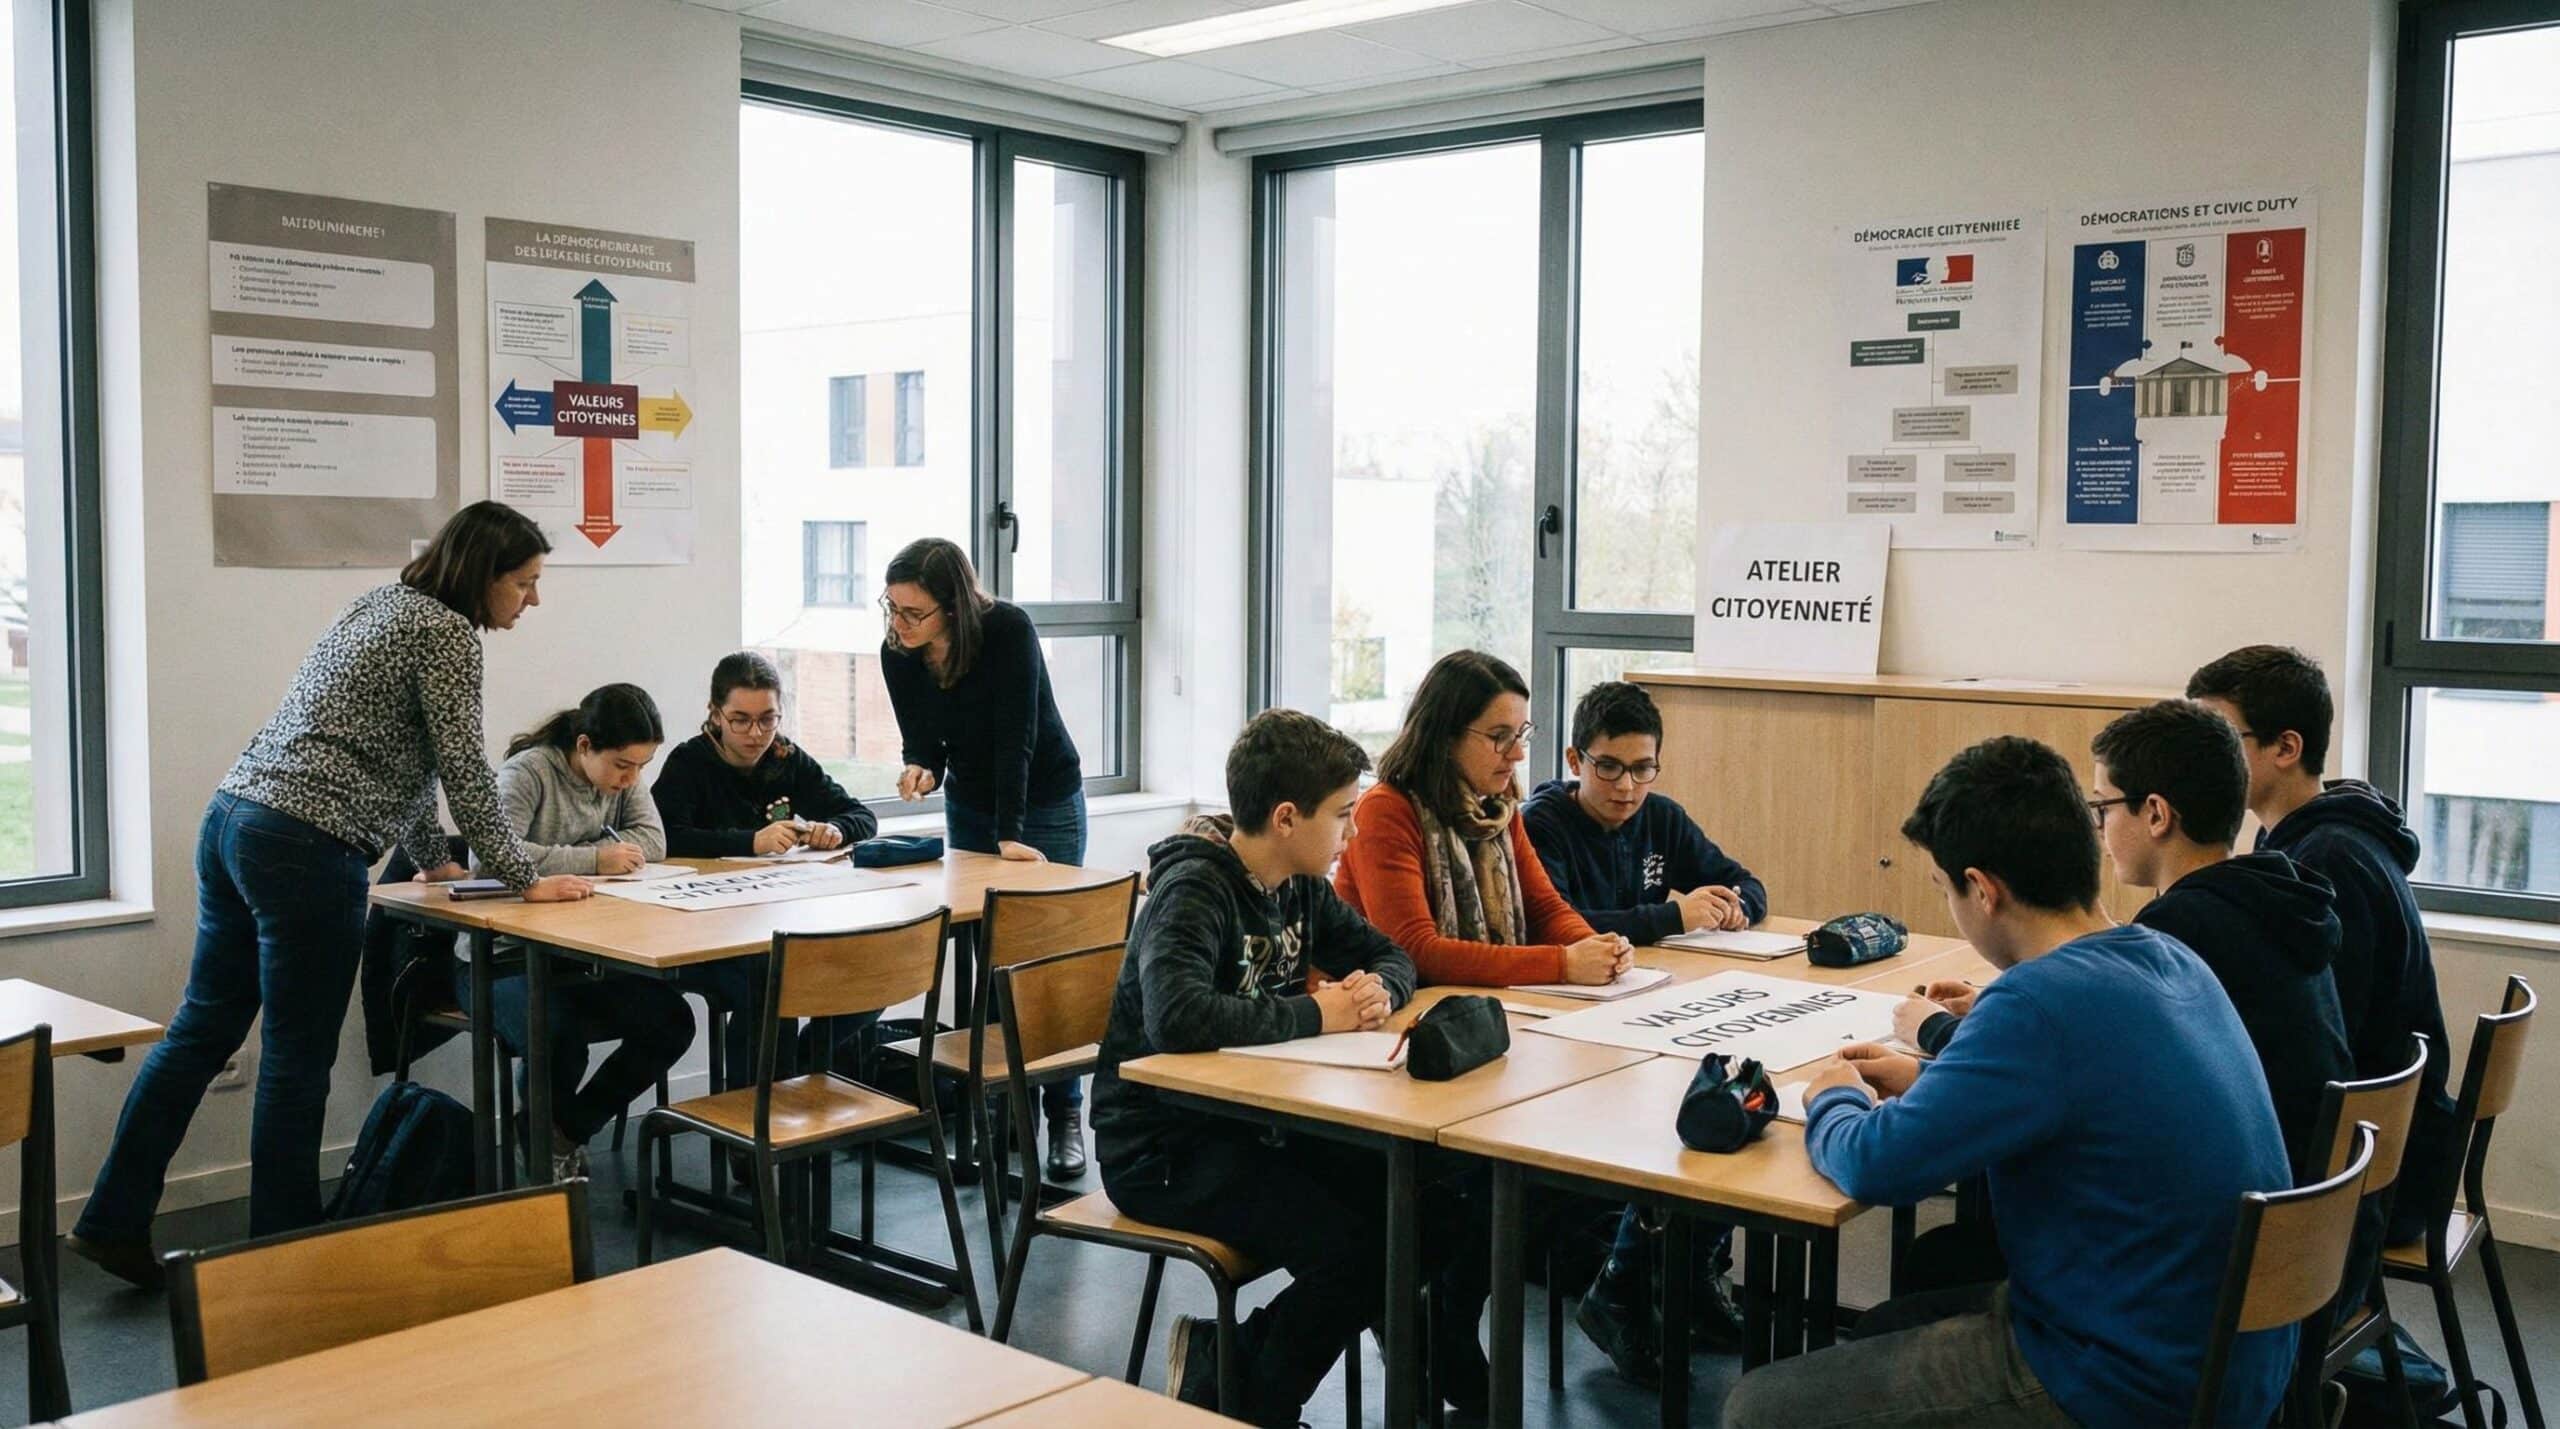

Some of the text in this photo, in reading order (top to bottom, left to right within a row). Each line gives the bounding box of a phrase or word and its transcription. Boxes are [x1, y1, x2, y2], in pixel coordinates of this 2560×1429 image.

[2081, 197, 2299, 226] DÉMOCRATIONS ET CIVIC DUTY
[536, 232, 551, 243] LA
[1854, 226, 1934, 243] DÉMOCRACIE
[515, 246, 537, 257] DES
[568, 394, 624, 408] VALEURS
[557, 410, 637, 427] CITOYENNES
[1746, 560, 1841, 583] ATELIER
[1711, 595, 1872, 623] CITOYENNETÉ
[1622, 987, 1771, 1028] VALEURS
